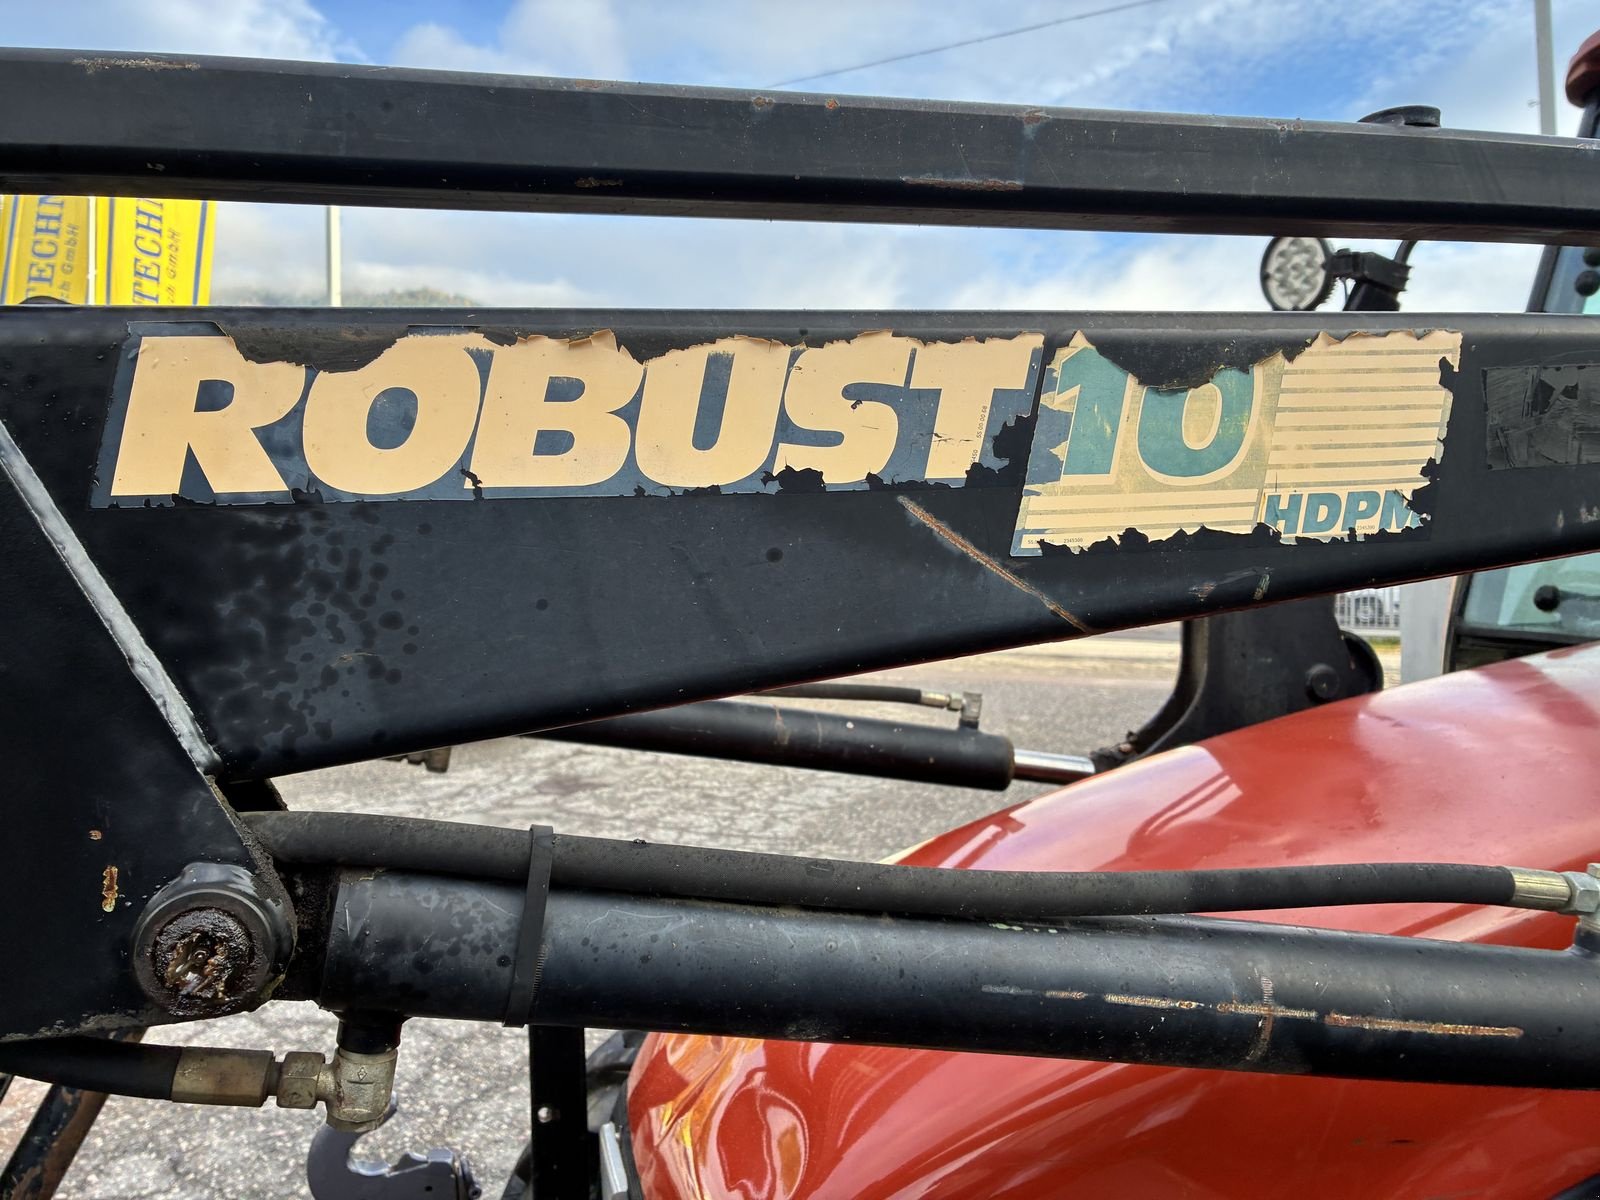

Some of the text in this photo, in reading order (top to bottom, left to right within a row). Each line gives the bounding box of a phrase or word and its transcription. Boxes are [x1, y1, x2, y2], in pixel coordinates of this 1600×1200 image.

[61, 223, 80, 275] GmbH
[166, 228, 181, 279] GmbH
[110, 328, 1045, 496] ROBUST
[1055, 346, 1258, 482] 10
[1264, 489, 1422, 535] HDPM
